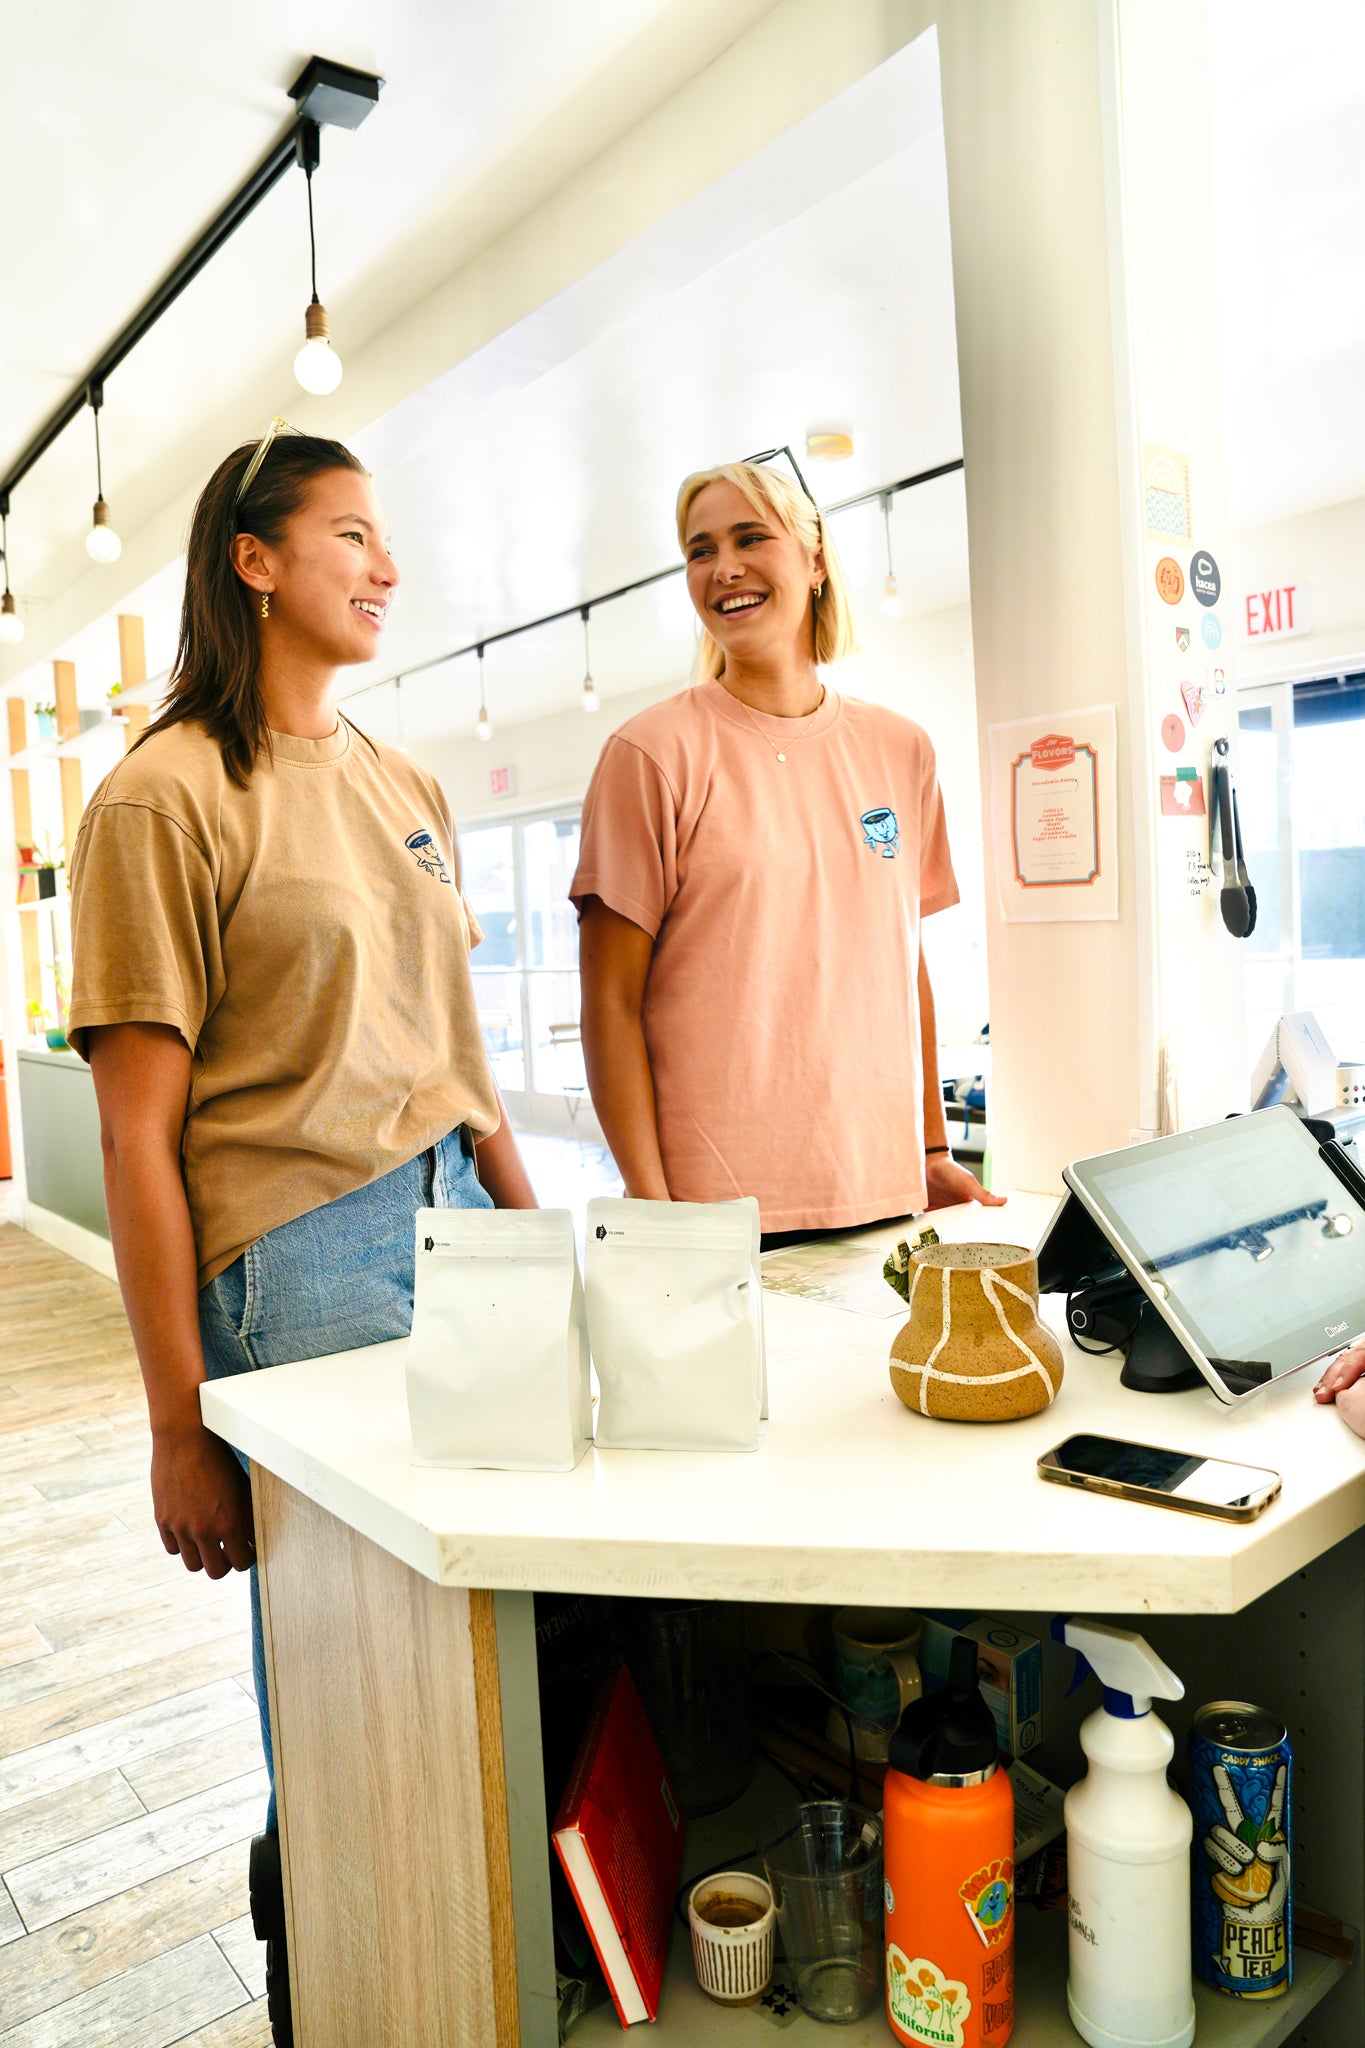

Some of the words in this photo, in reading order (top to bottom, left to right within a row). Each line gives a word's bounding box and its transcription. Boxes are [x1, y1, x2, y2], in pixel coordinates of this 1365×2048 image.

[1195, 575, 1217, 592] hacea
[1246, 586, 1296, 636] EXIT
[1221, 1753, 1250, 1766] CADDY
[1226, 1922, 1283, 1955] PEACE
[1237, 1954, 1275, 1979] TEA
[891, 2001, 955, 2042] California
